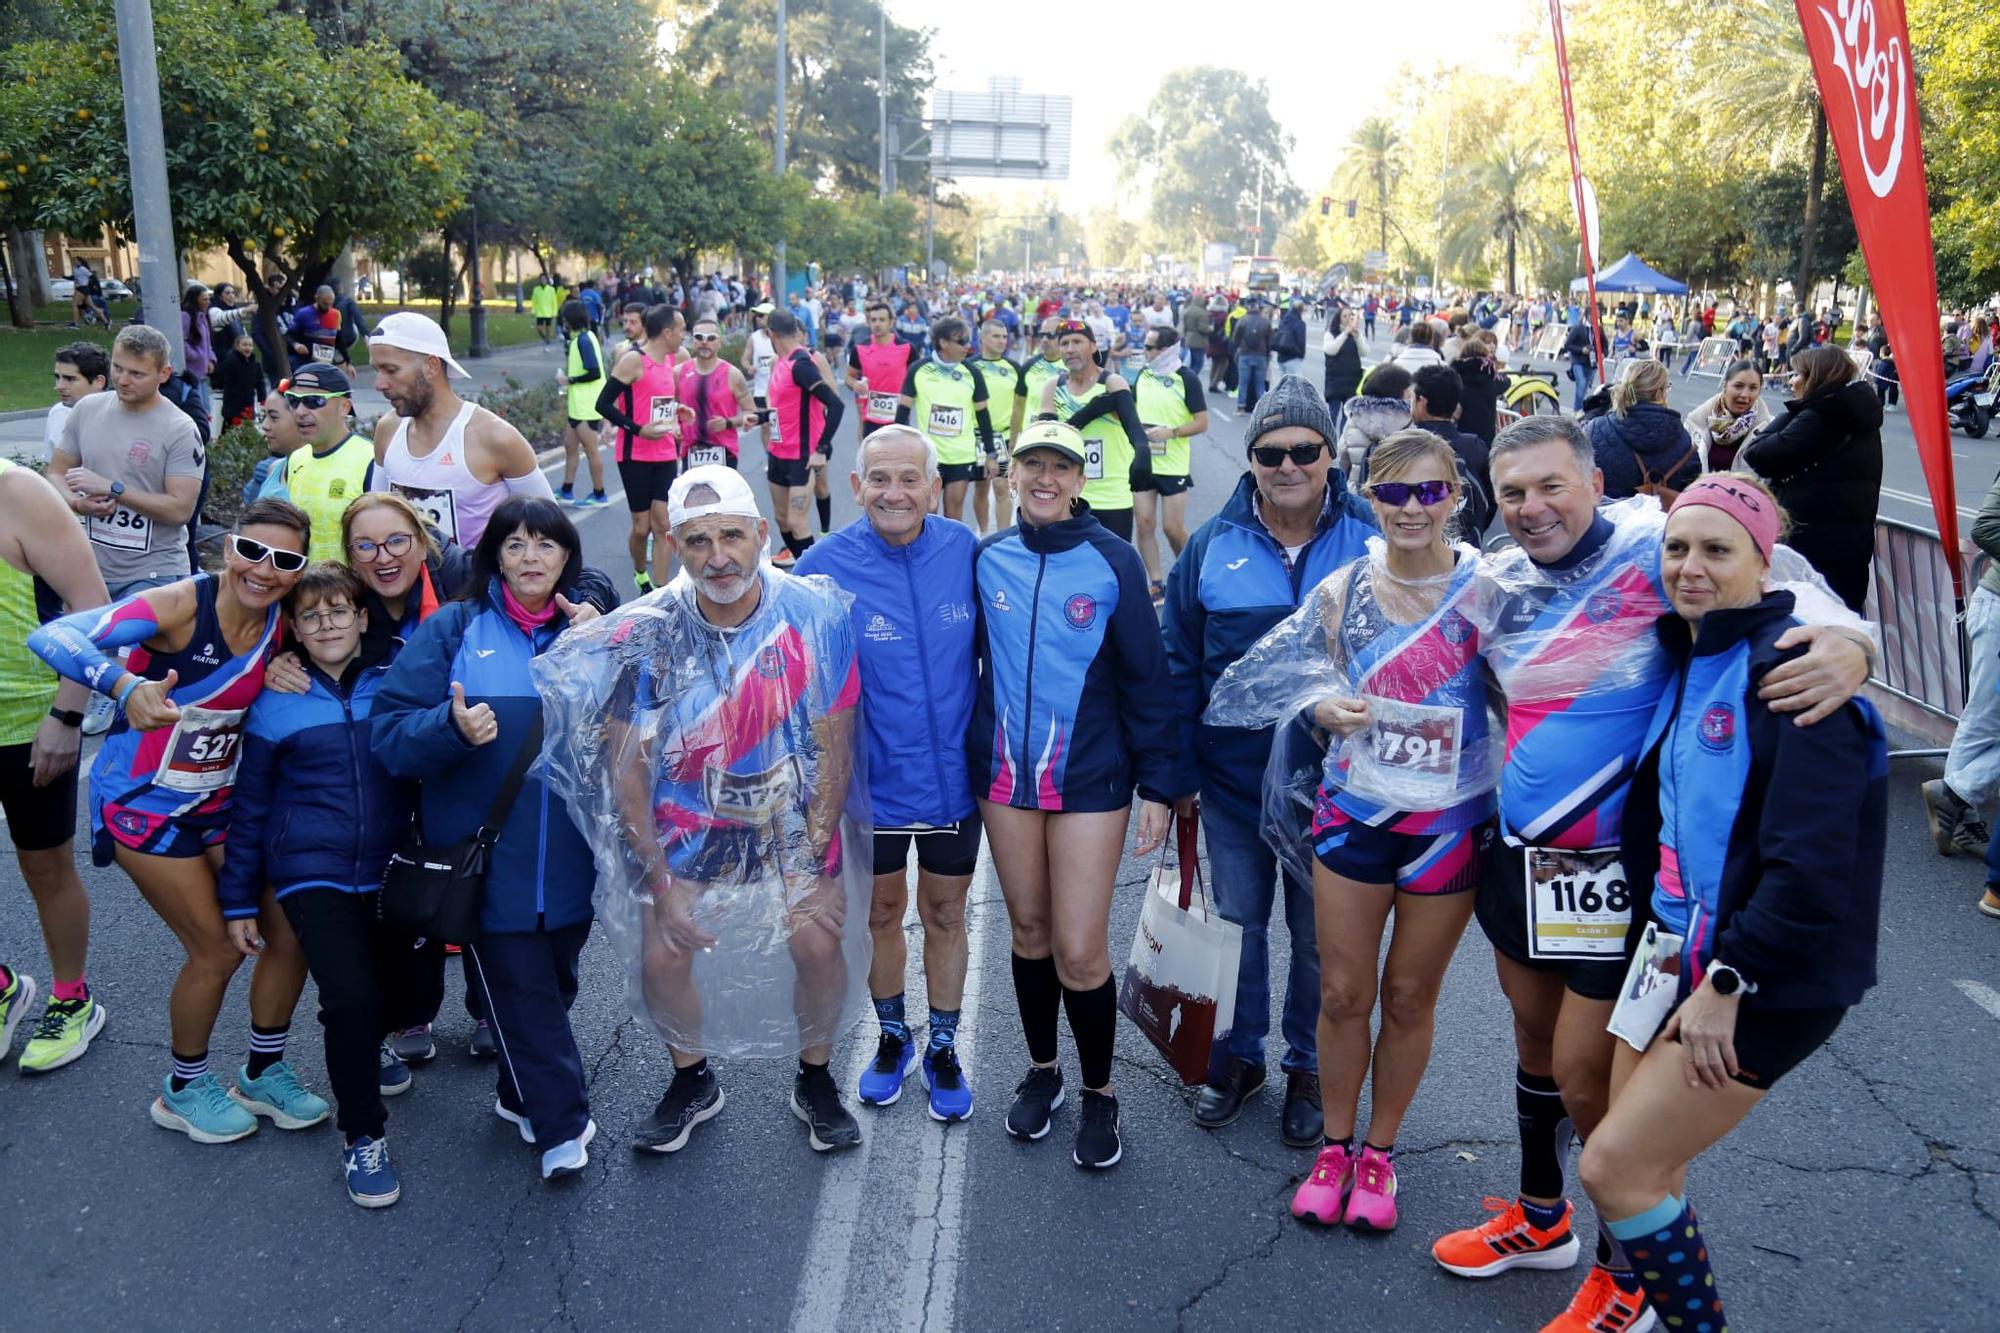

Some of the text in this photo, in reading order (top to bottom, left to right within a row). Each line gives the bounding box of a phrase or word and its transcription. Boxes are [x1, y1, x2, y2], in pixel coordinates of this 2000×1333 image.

[873, 399, 893, 410] 802
[933, 412, 957, 425] 1416
[693, 451, 719, 462] 1776
[192, 654, 219, 665] VIATOR
[188, 733, 239, 761] 527
[1551, 879, 1632, 913] 1168
